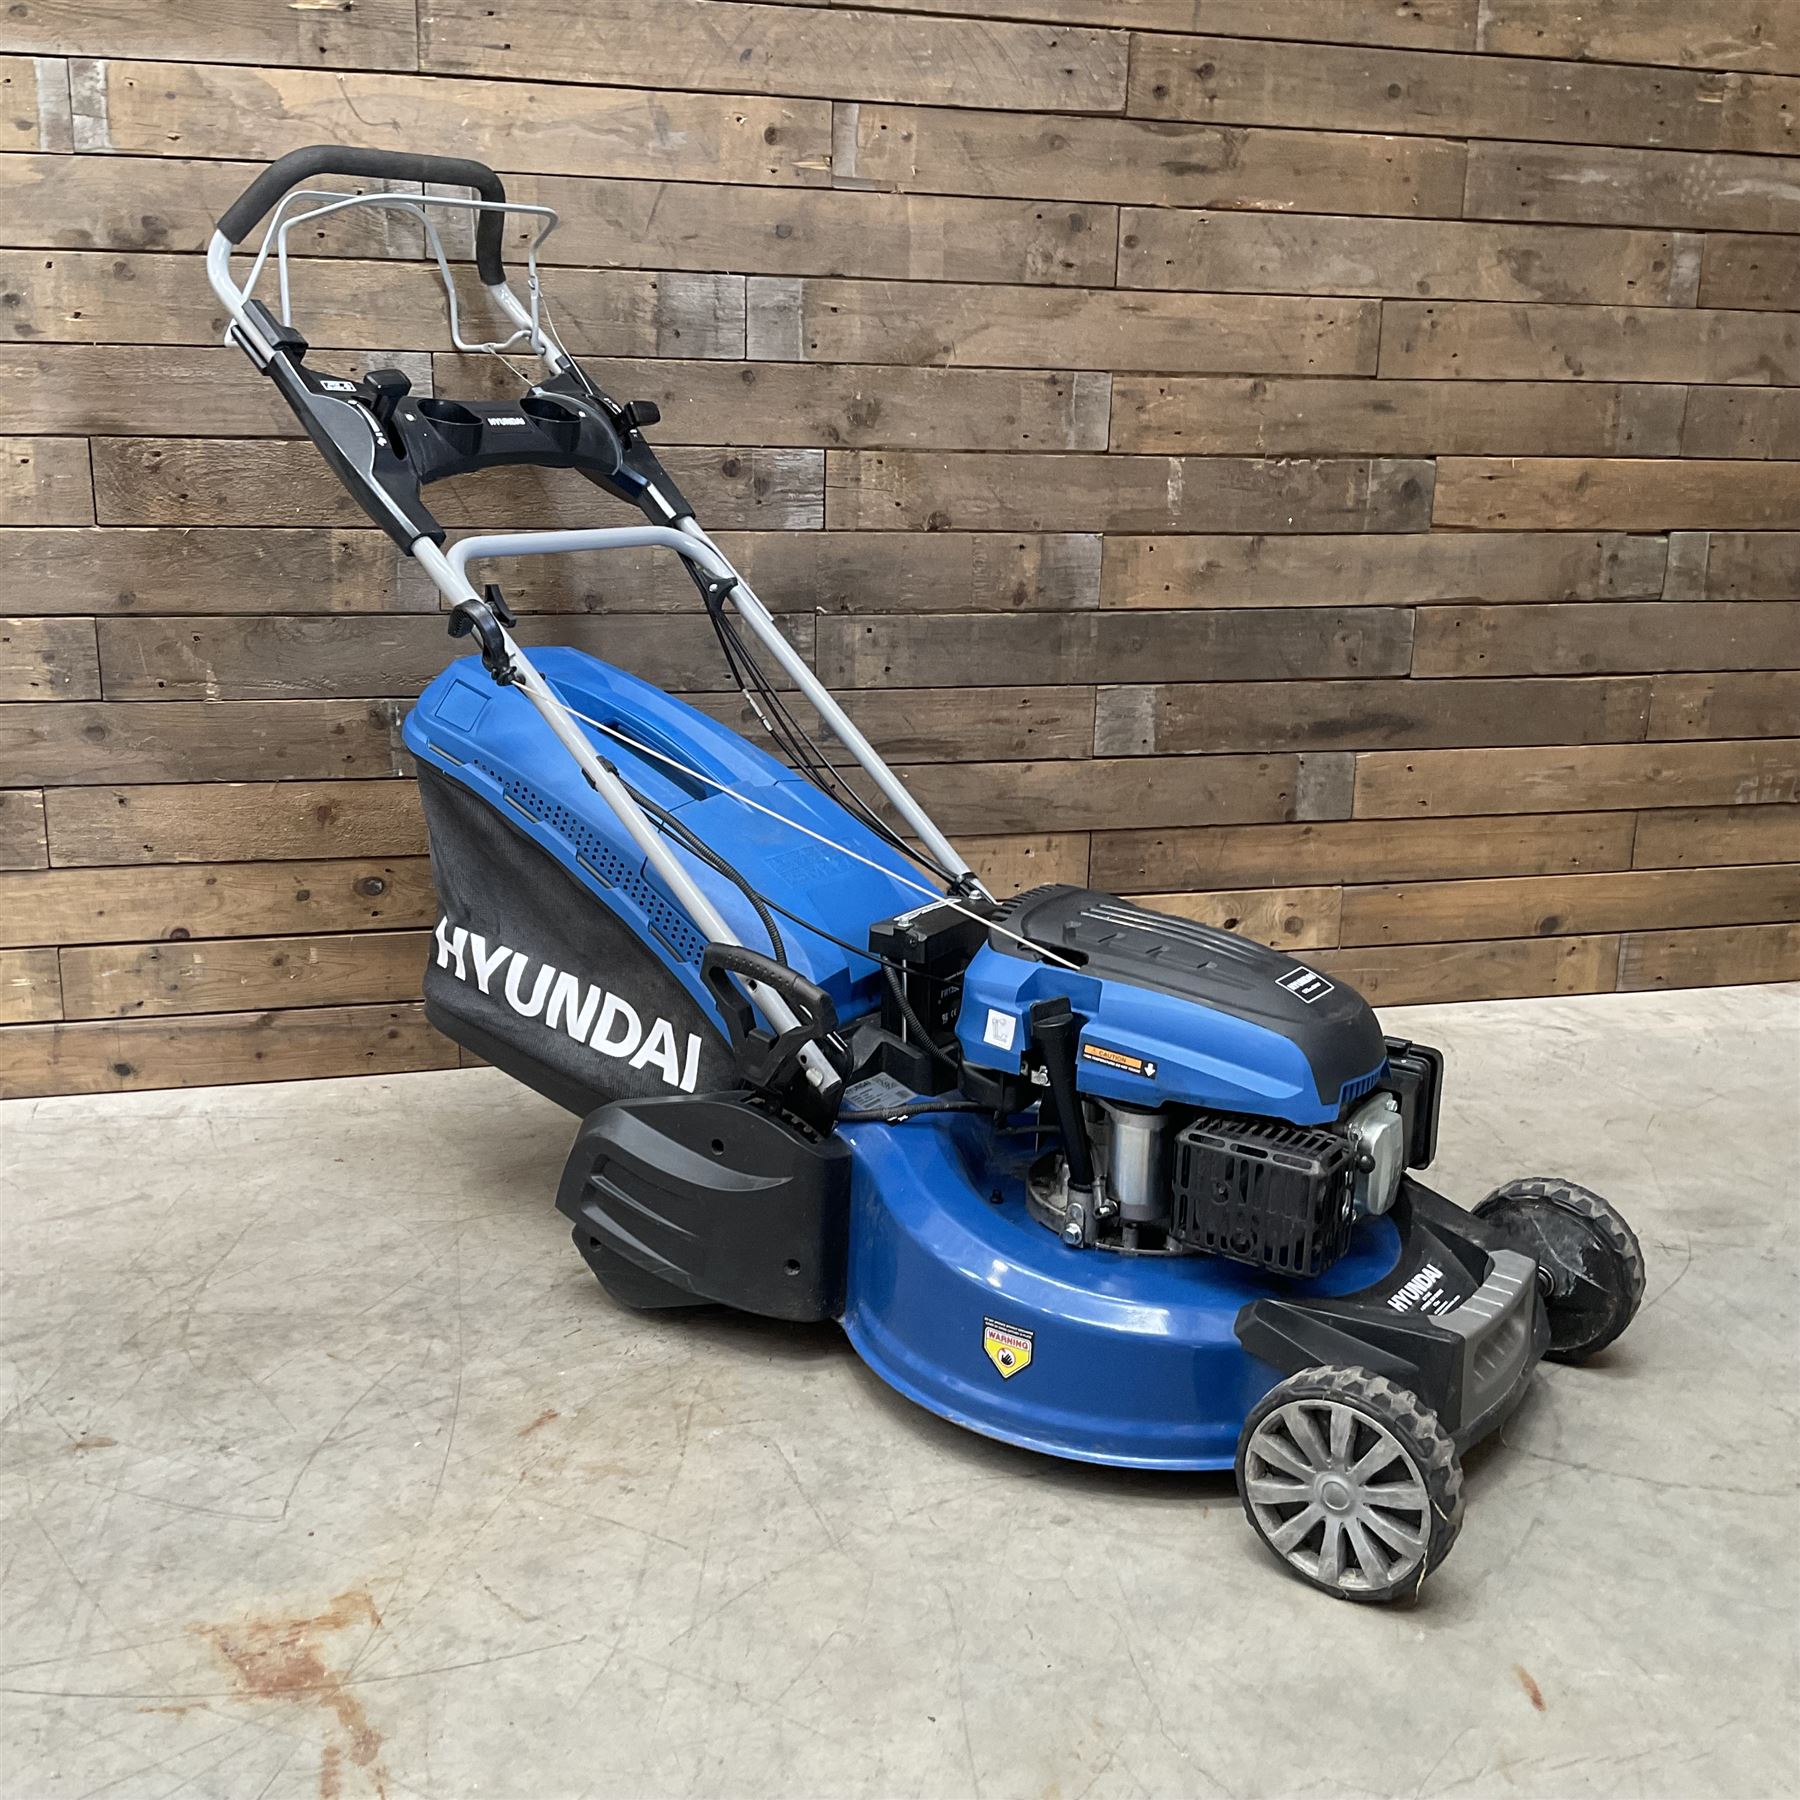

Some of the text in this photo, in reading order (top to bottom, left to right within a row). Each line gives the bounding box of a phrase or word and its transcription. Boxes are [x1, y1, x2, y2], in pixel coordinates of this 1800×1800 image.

[435, 915, 702, 1094] HYUNDAI
[1098, 1050, 1127, 1063] CAUTION
[1386, 1263, 1444, 1313] HYUNDAI
[988, 1330, 1028, 1349] WARNING
